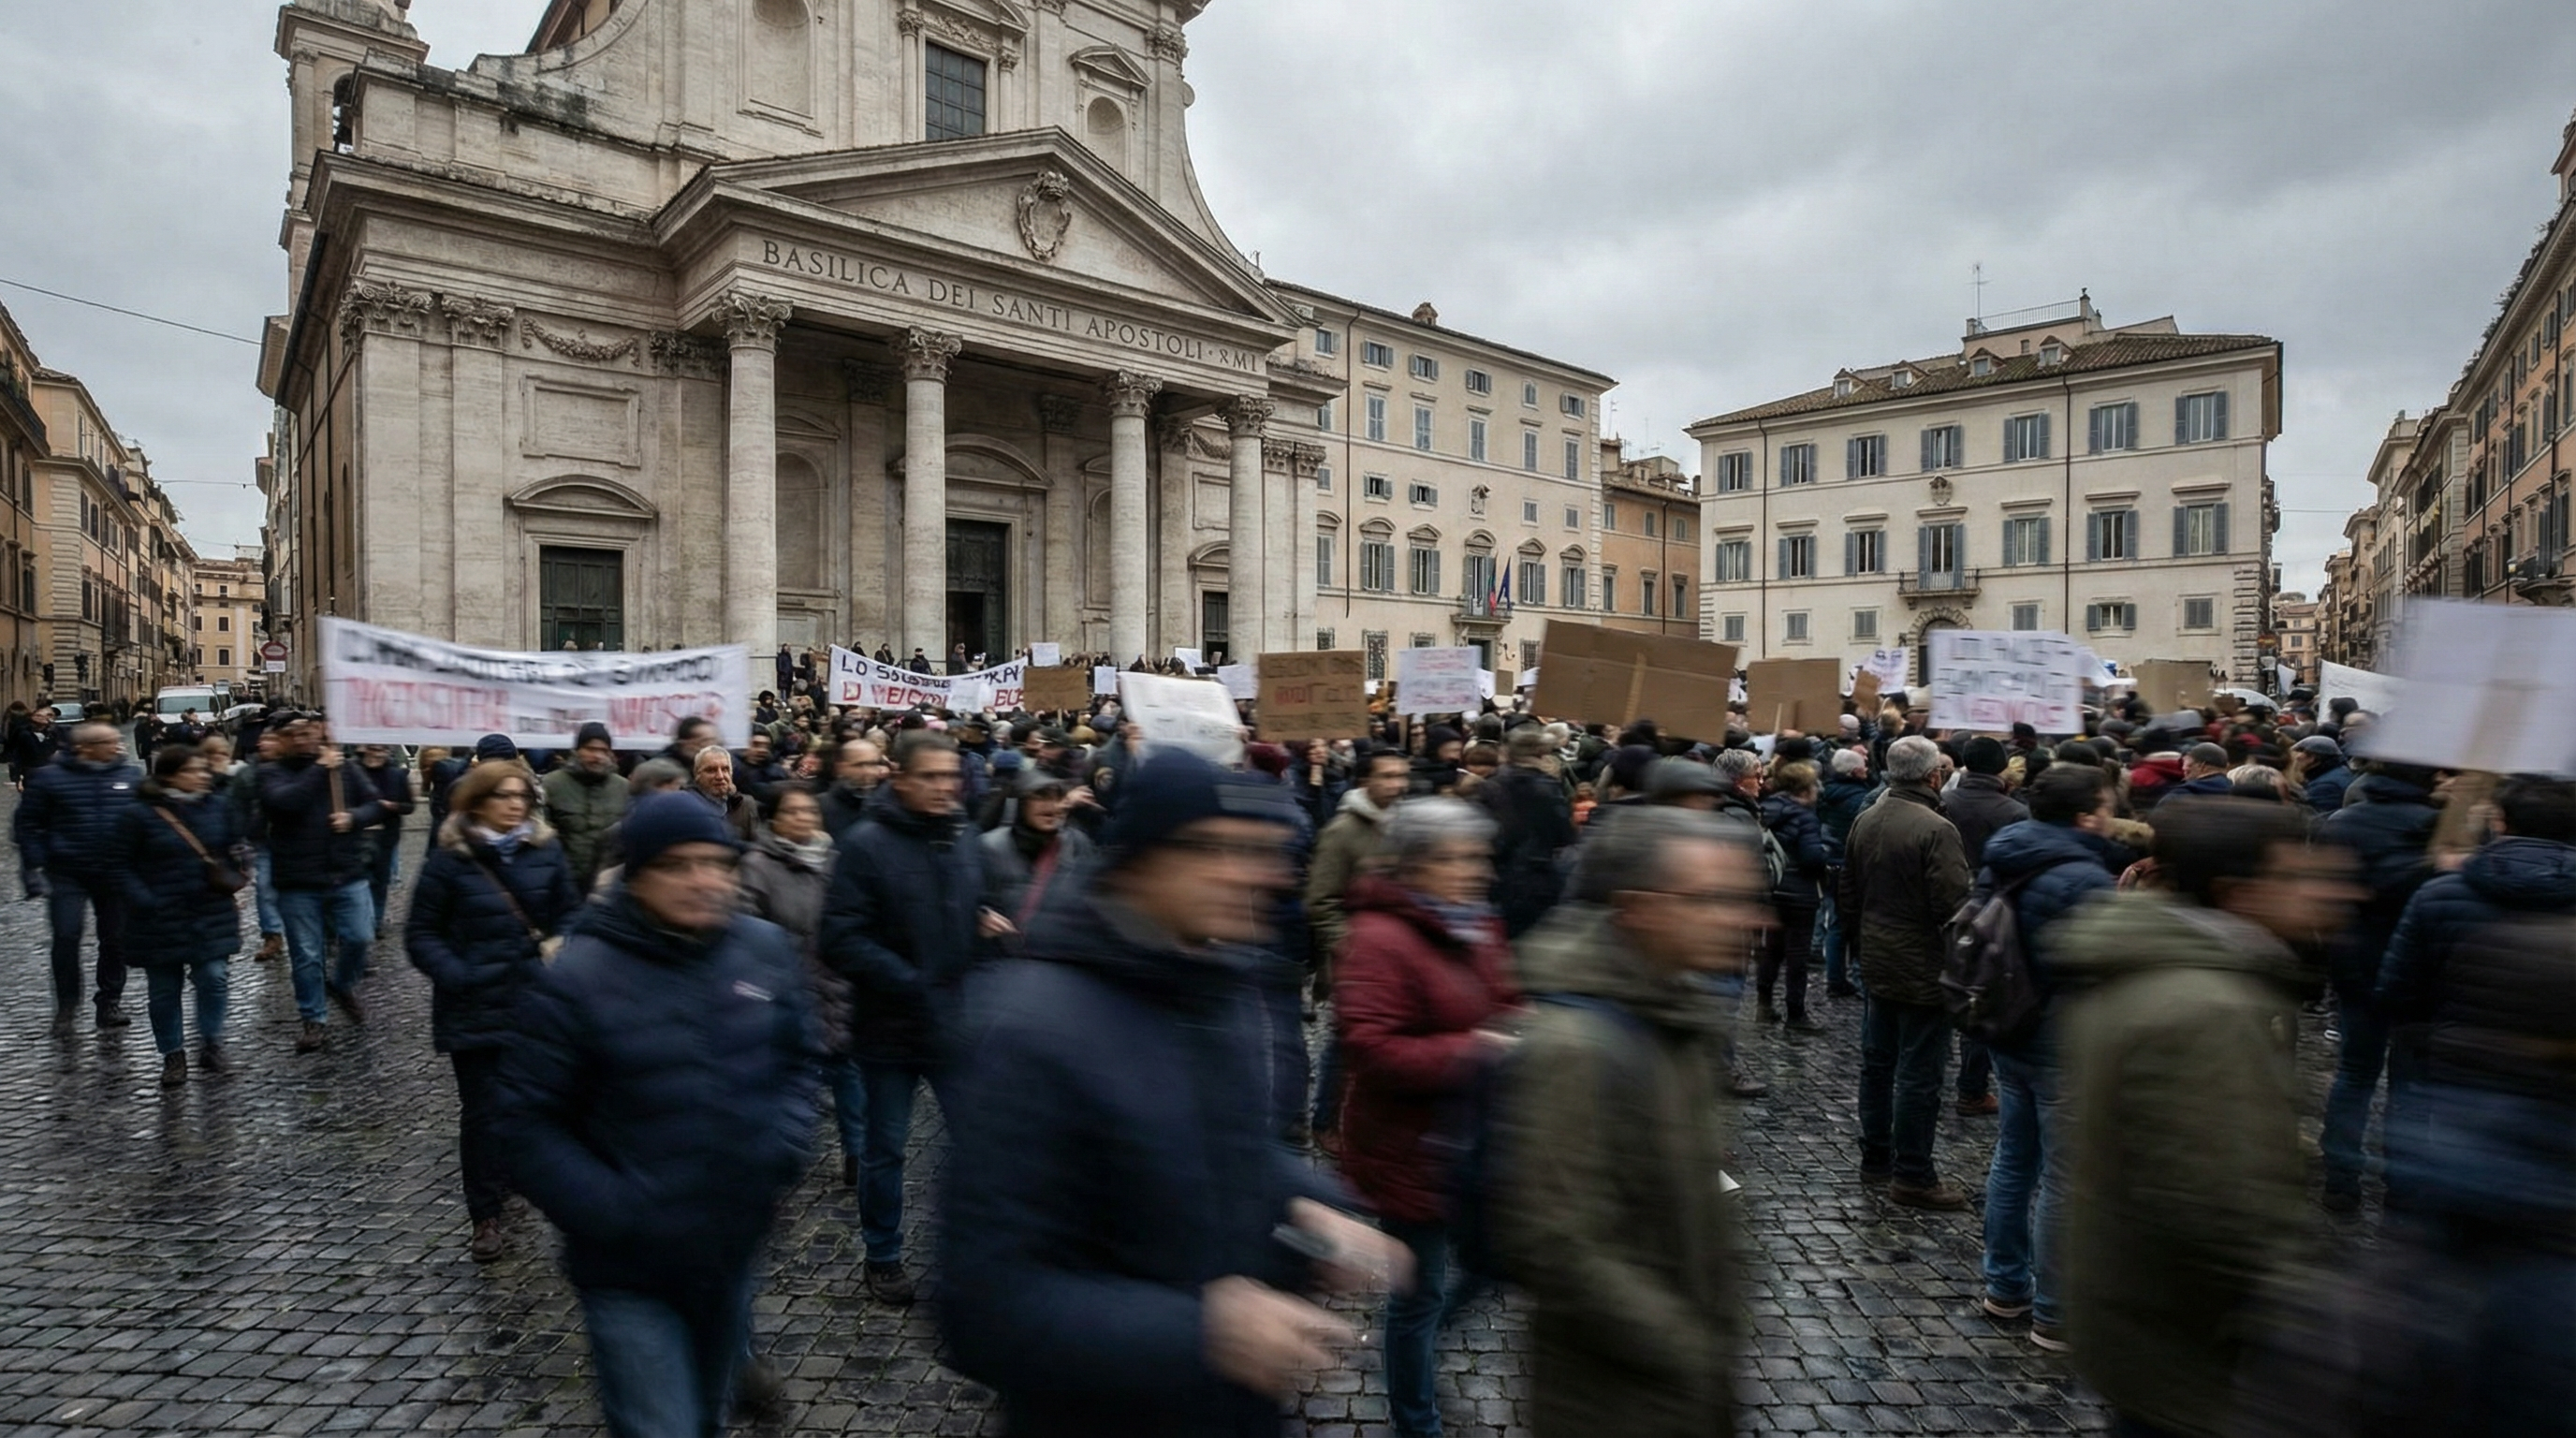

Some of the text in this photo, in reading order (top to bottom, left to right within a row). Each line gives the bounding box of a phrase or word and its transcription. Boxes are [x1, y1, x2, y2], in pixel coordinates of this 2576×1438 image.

[763, 240, 911, 295] BASILICA
[929, 278, 976, 309] DEI
[992, 294, 1071, 330] SANTI
[842, 654, 868, 676] LO
